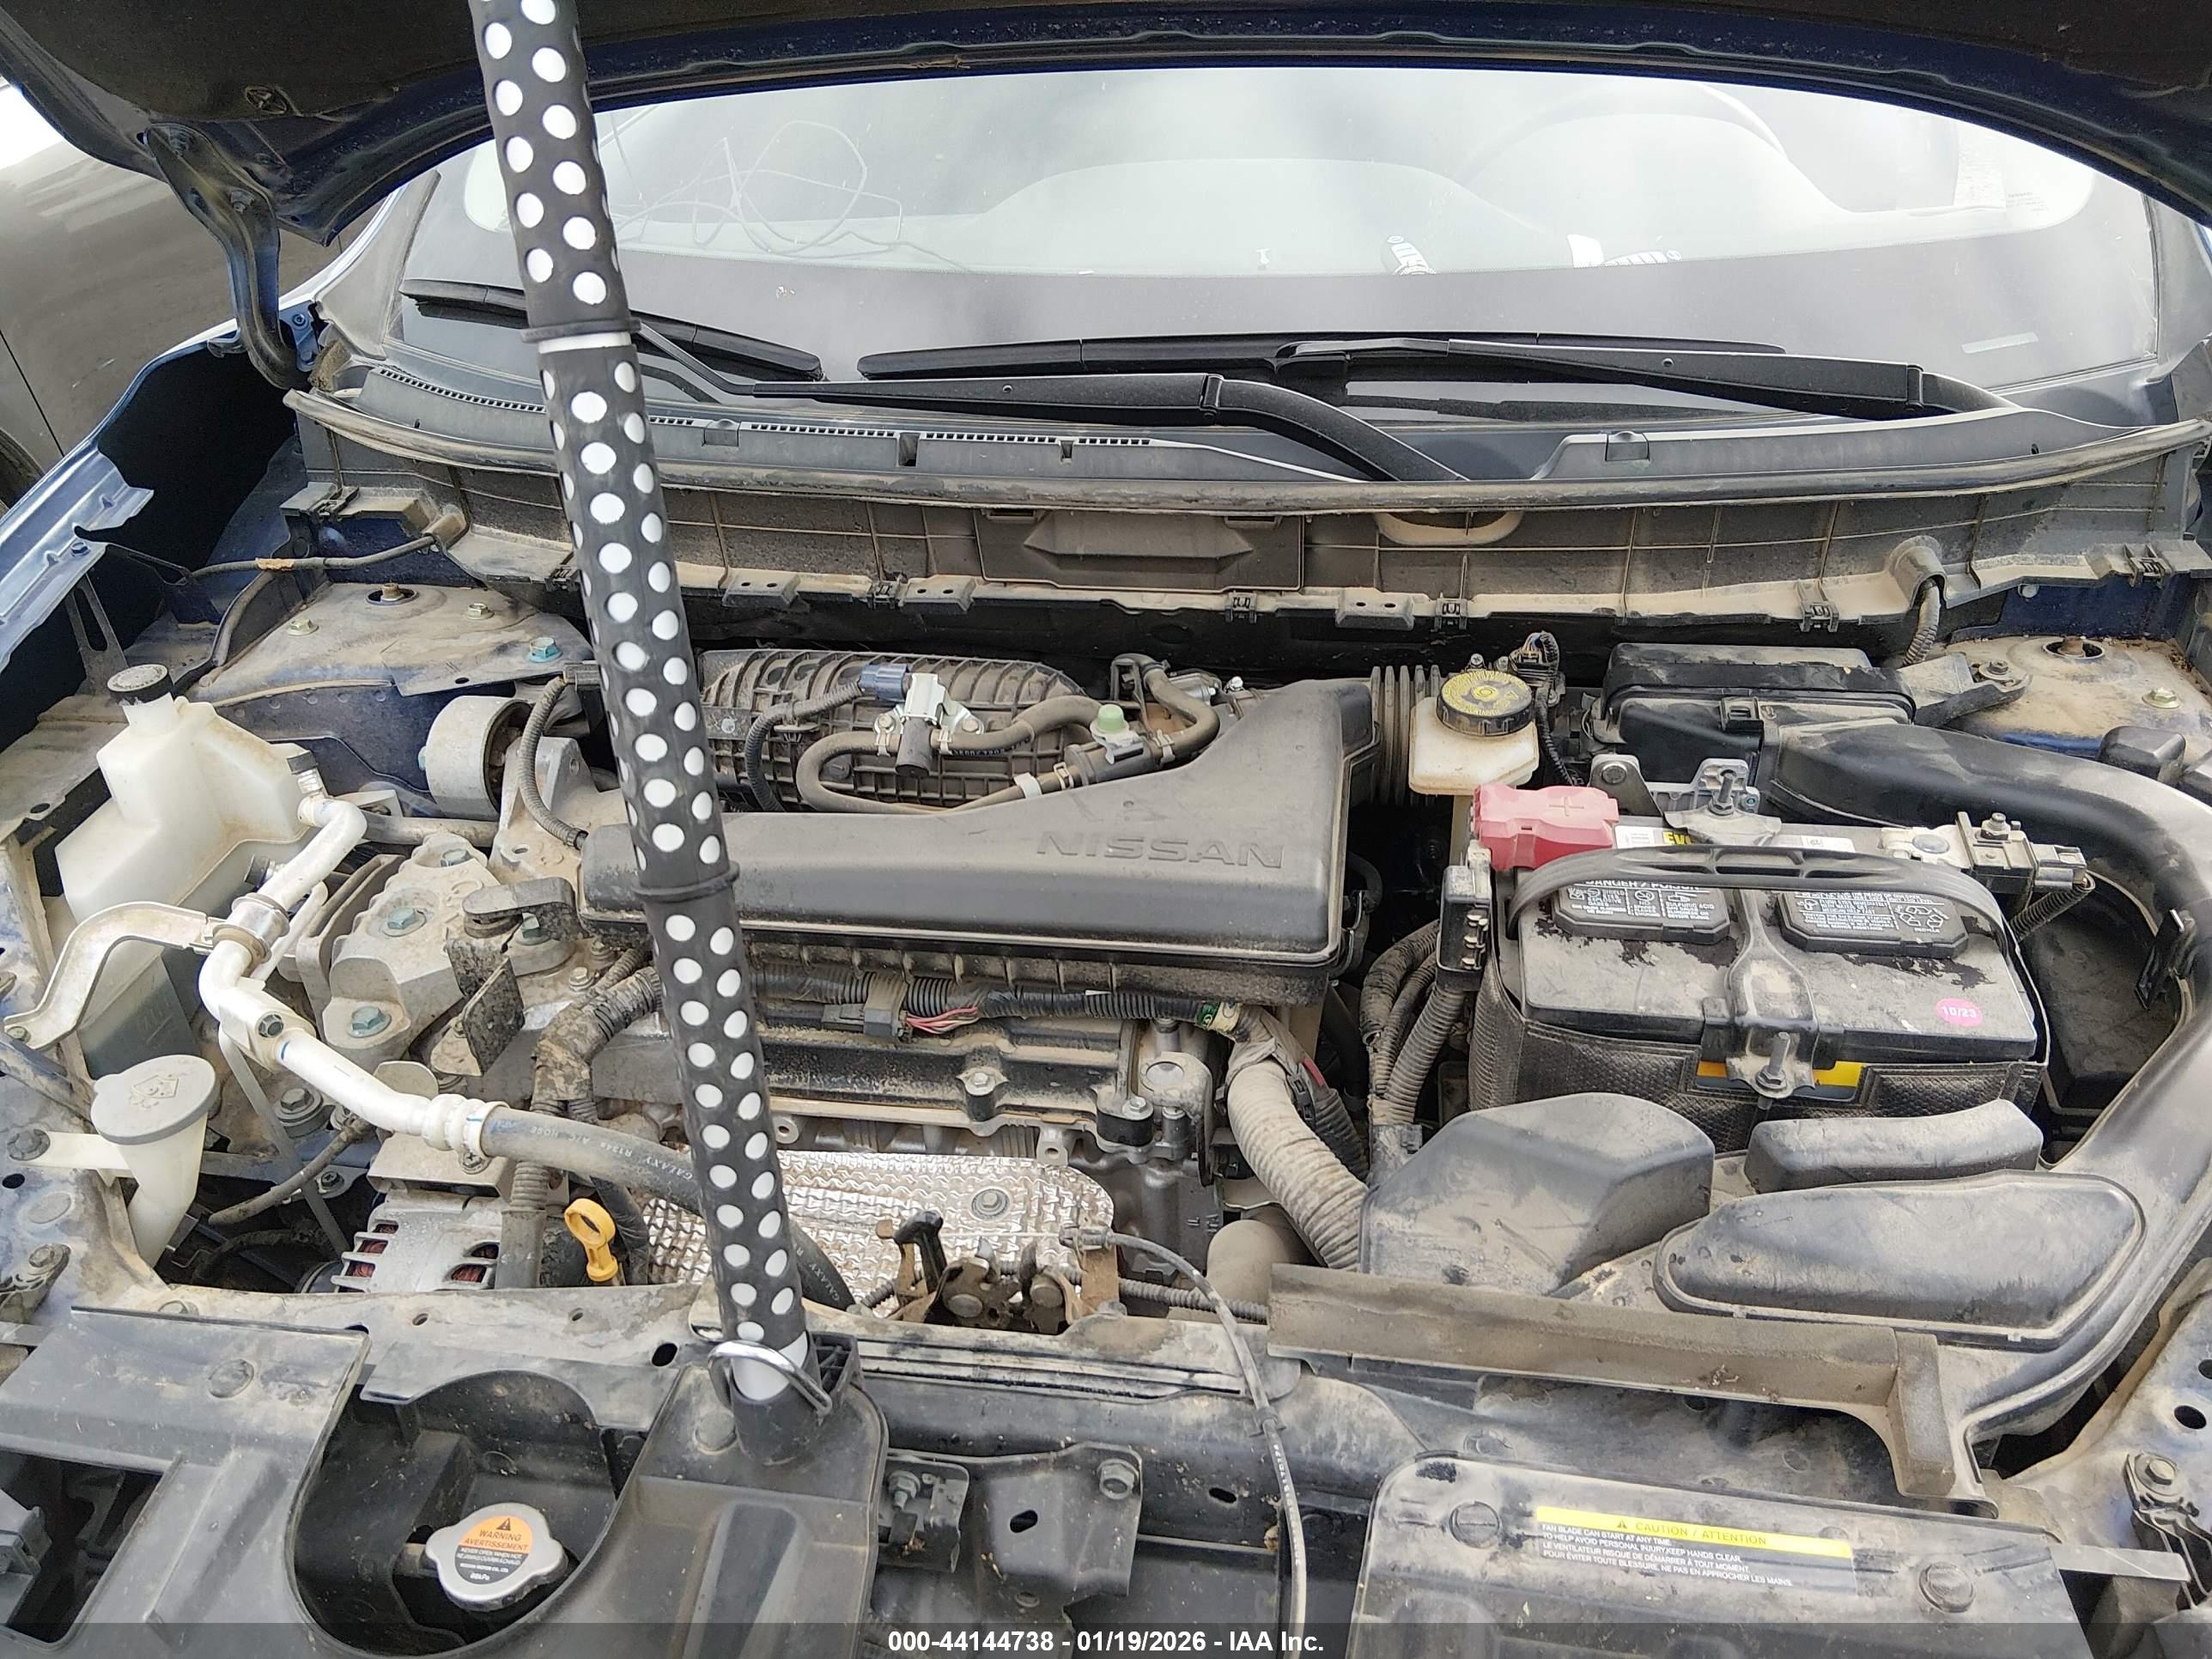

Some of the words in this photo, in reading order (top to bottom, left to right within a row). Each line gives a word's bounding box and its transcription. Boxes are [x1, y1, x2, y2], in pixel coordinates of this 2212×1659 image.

[1036, 830, 1285, 869] NISSAN
[1941, 1006, 1978, 1018] 10/23
[530, 1125, 559, 1139] HOSE
[568, 1133, 591, 1146] A/C
[599, 1140, 633, 1158] R134a
[642, 1155, 694, 1181] GALAXY
[479, 1530, 522, 1541] WARNING
[1558, 1526, 1583, 1535] BLADE
[1583, 1529, 1601, 1538] CAN
[1601, 1531, 1625, 1540] START
[1636, 1534, 1652, 1543] ANY
[1635, 1522, 1688, 1536] CAUTION
[1702, 1530, 1766, 1545] ATTENTION
[465, 1538, 528, 1550] AVERTISSEMENT
[1554, 1534, 1574, 1542] HELP
[1575, 1536, 1597, 1546] AVOID
[1599, 1539, 1639, 1551] PERSONAL
[1686, 1550, 1714, 1559] HANDS
[1553, 1543, 1601, 1554] VENTILATEUR
[1602, 1548, 1631, 1559] RISQUE
[1632, 1552, 1643, 1560] DE
[1644, 1553, 1686, 1565] DÉMARRER
[1694, 1559, 1715, 1568] TOUT
[1544, 1549, 1565, 1559] POUR
[1566, 1551, 1592, 1563] ÉVITER
[1593, 1555, 1618, 1565] TOUTE
[1661, 1565, 1672, 1573] NE
[1673, 1565, 1689, 1575] PAS
[1689, 1568, 1701, 1577] EN
[1702, 1570, 1750, 1582] APPROCHER
[1751, 1574, 1765, 1583] LES
